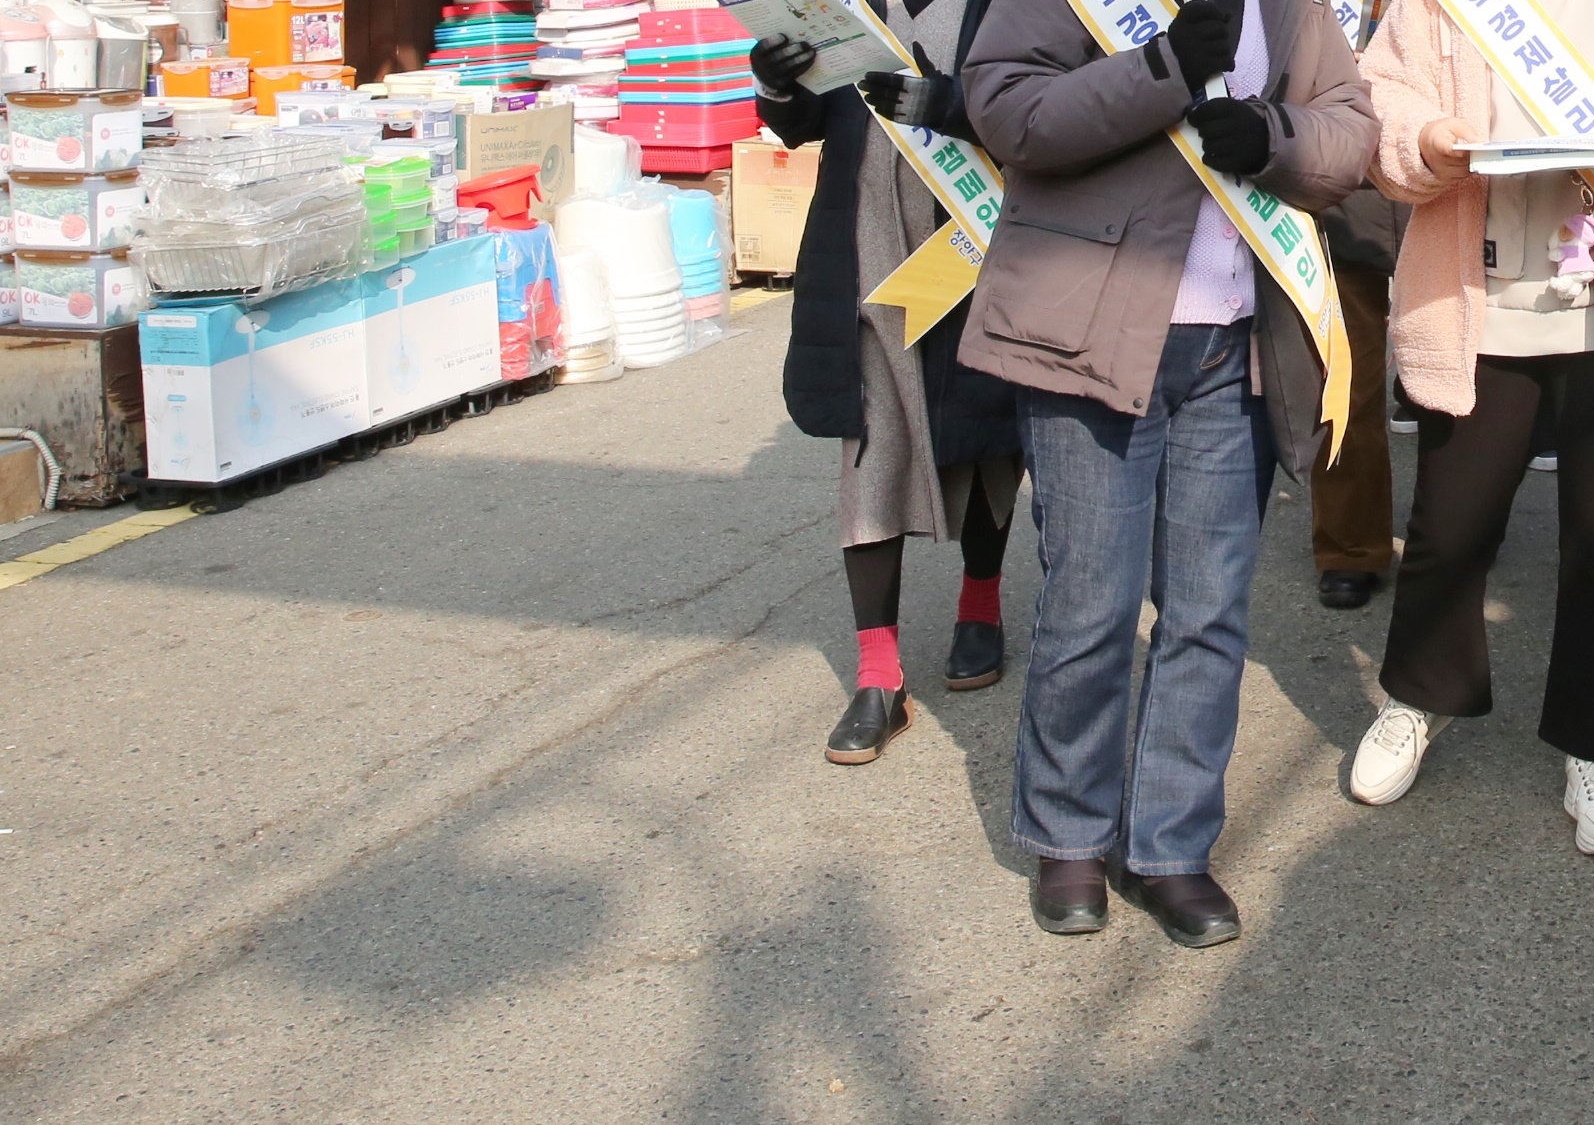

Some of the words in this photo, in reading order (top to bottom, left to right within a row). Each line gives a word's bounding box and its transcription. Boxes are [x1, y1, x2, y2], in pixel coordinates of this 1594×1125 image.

[15, 137, 30, 149] OK
[0, 220, 13, 233] OK
[17, 216, 33, 228] OK
[948, 228, 983, 267] 장안구
[0, 291, 16, 304] OK
[24, 292, 40, 304] OK
[310, 329, 355, 349] HJ-55KSF
